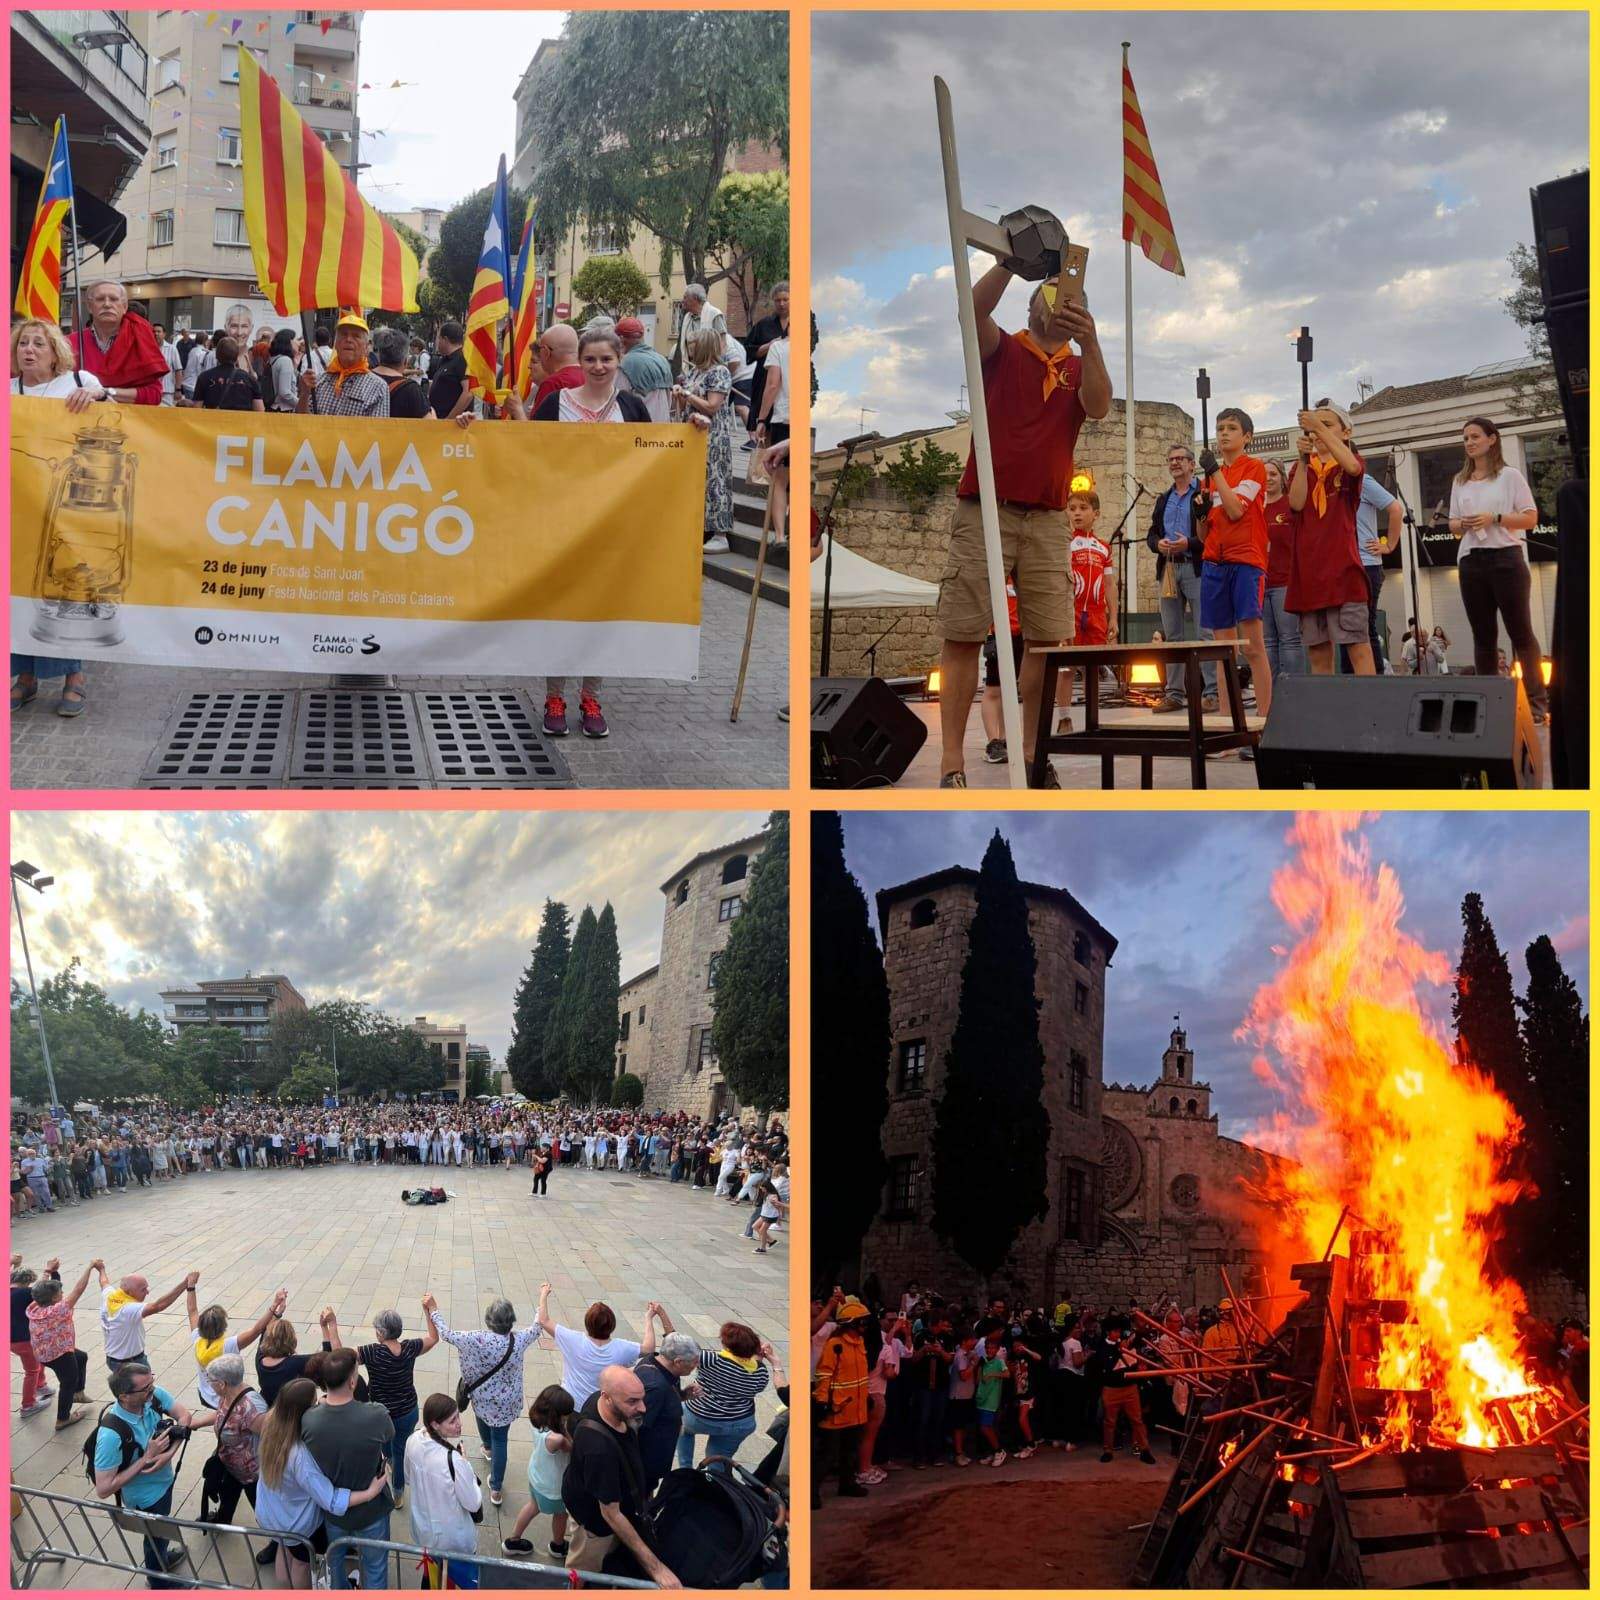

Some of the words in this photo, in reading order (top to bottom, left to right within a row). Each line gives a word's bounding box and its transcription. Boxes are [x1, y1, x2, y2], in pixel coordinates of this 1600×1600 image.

[635, 437, 685, 448] flama.cat
[214, 435, 432, 492] FLAMA
[442, 444, 474, 458] DEL
[205, 489, 475, 556] CANIGÓ
[203, 560, 218, 573] 23
[222, 561, 237, 574] de
[240, 562, 267, 577] juny
[270, 563, 296, 577] Focs
[297, 565, 311, 578] de
[313, 566, 337, 580] Sant
[339, 568, 364, 581] Joan
[201, 581, 217, 594] 24
[220, 582, 235, 596] de
[239, 583, 265, 599] juny
[268, 584, 296, 599] Festa
[299, 586, 344, 602] Nacional
[347, 588, 369, 602] dels
[409, 591, 455, 607] Catalans
[217, 629, 280, 644] ÒMNIUM
[313, 634, 347, 643] FLAMA
